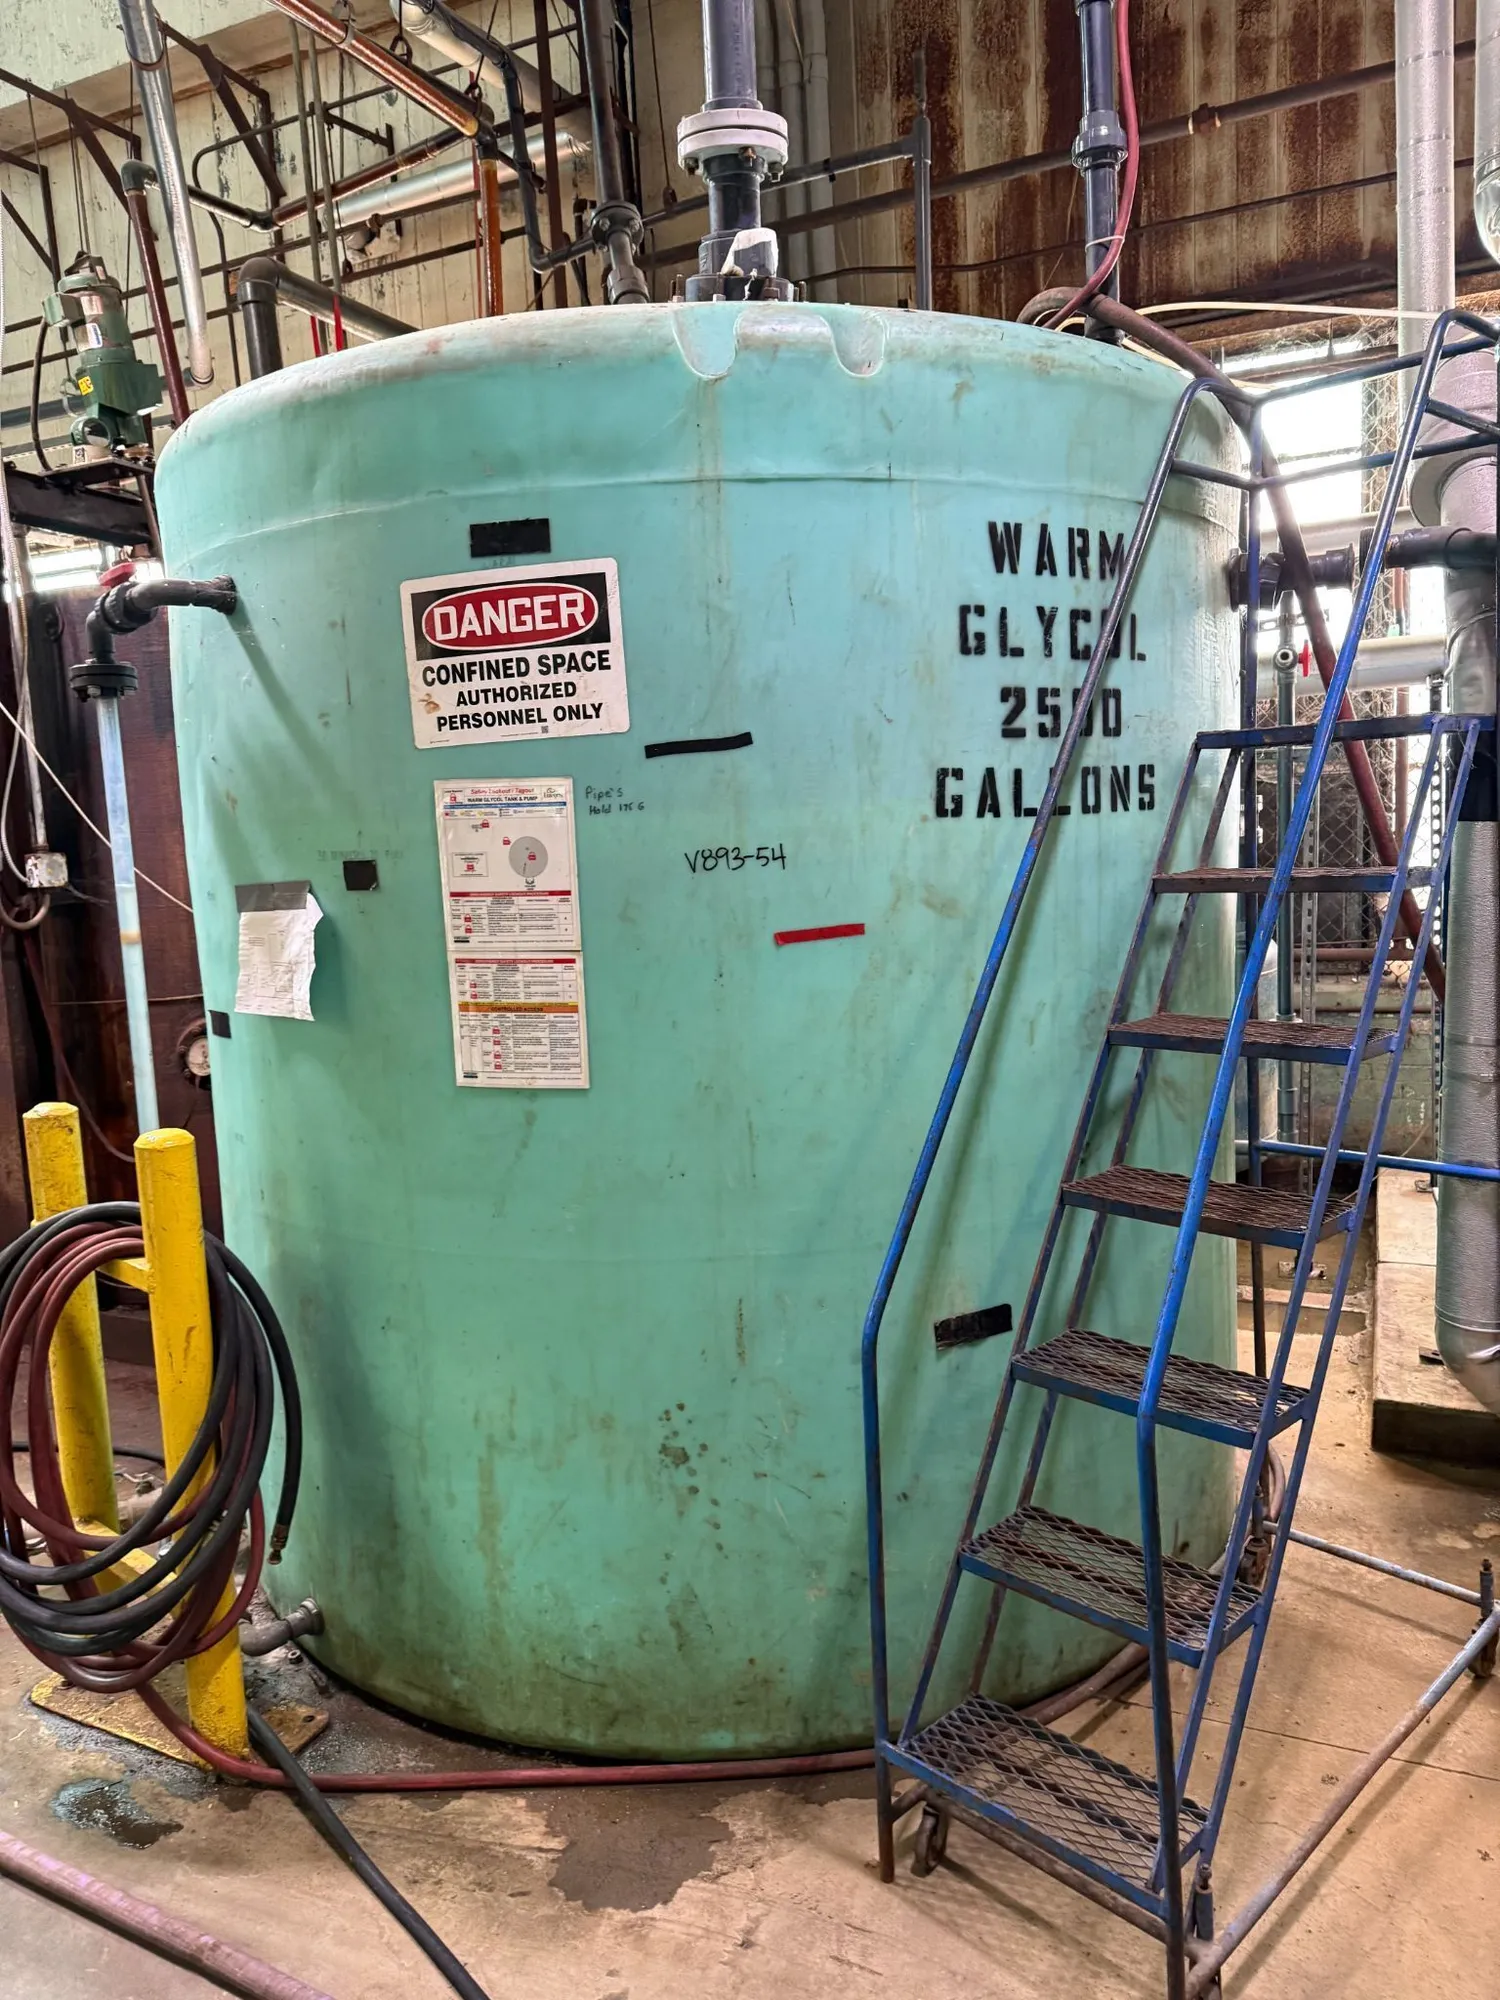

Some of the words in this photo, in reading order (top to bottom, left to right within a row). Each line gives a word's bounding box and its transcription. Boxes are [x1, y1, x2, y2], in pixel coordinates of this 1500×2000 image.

[988, 521, 1126, 581] WARM
[433, 592, 586, 641] DANGER
[422, 656, 530, 687] CONFINED
[537, 650, 611, 676] SPACE
[456, 681, 577, 707] AUTHORIZED
[437, 707, 547, 732] PERSONNEL
[553, 703, 603, 722] ONLY
[589, 804, 612, 815] Hold
[684, 843, 787, 873] V893-54
